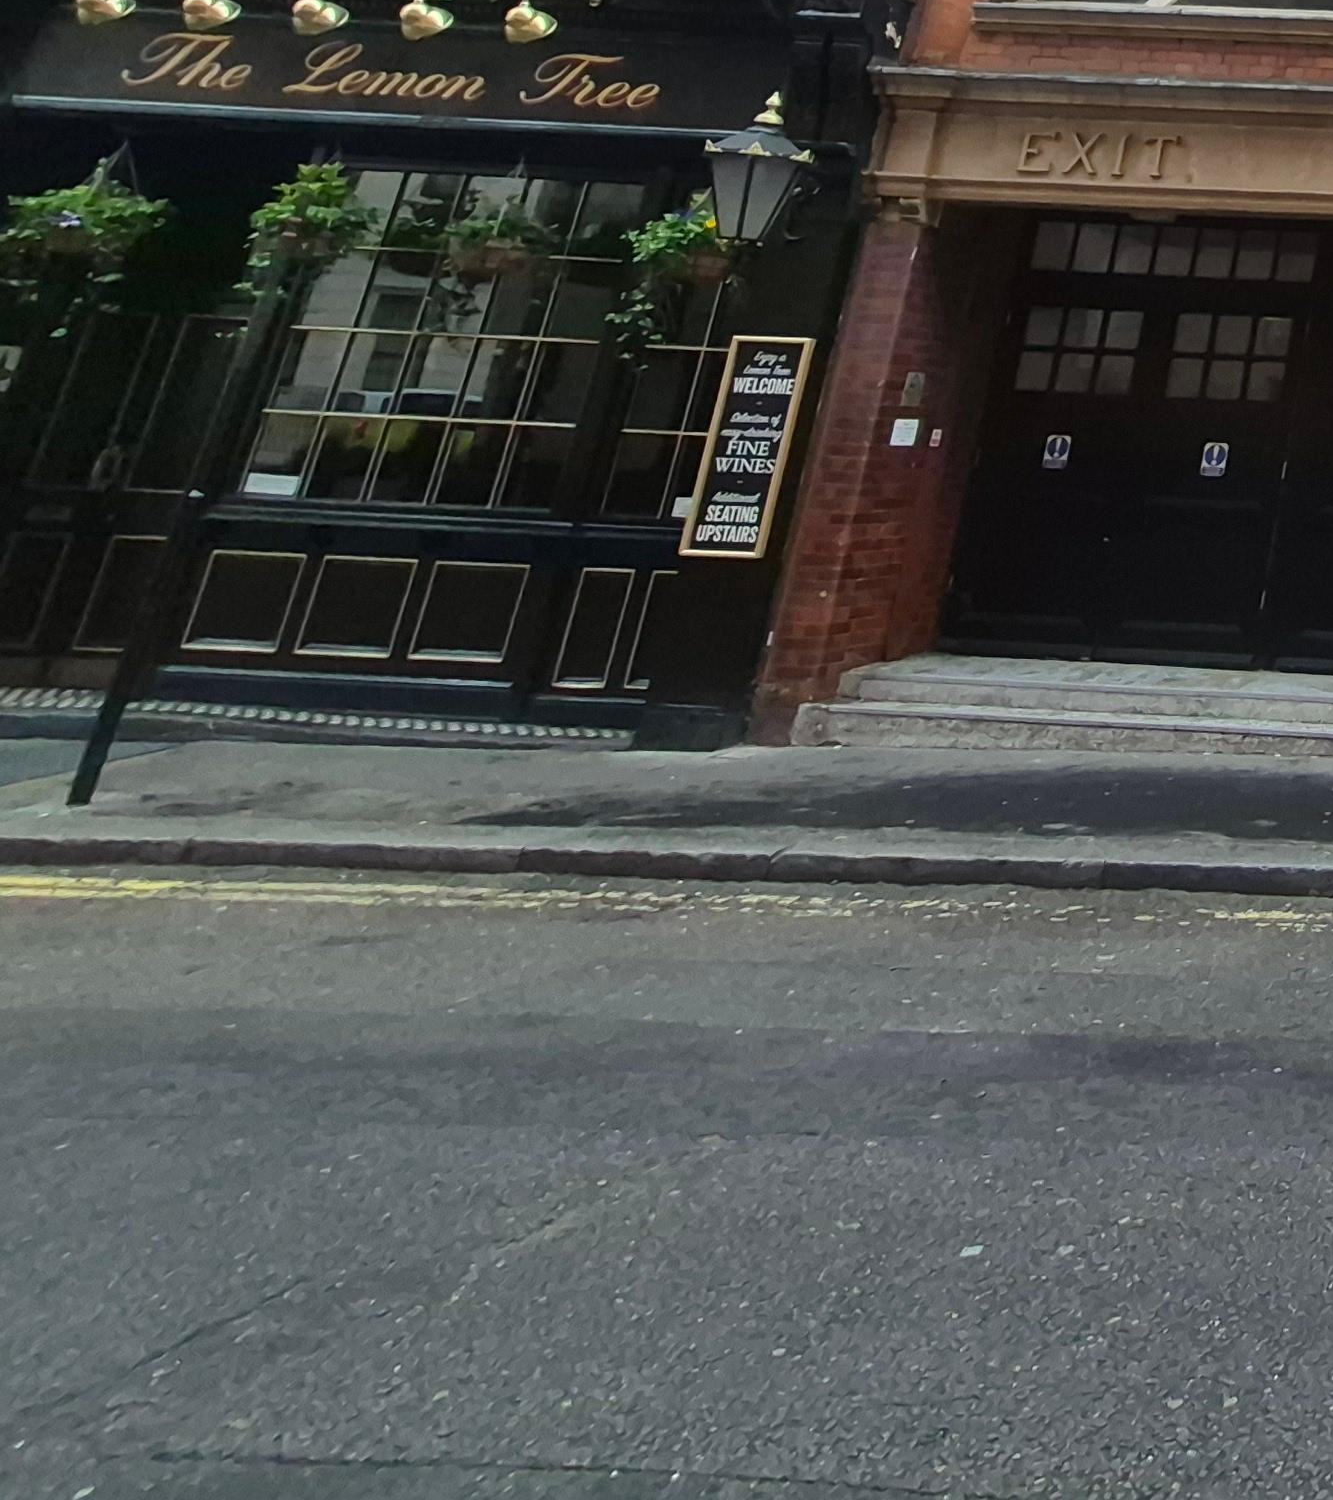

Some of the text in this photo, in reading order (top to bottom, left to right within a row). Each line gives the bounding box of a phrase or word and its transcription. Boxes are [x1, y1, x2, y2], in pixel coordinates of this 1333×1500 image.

[121, 32, 662, 108] The Lemon Tree
[1015, 132, 1182, 179] EXIT
[733, 376, 796, 395] WELCOME
[726, 440, 771, 457] FINE
[715, 456, 776, 474] WINES
[705, 504, 760, 523] SEATING
[696, 524, 759, 544] UPSTAIRS
